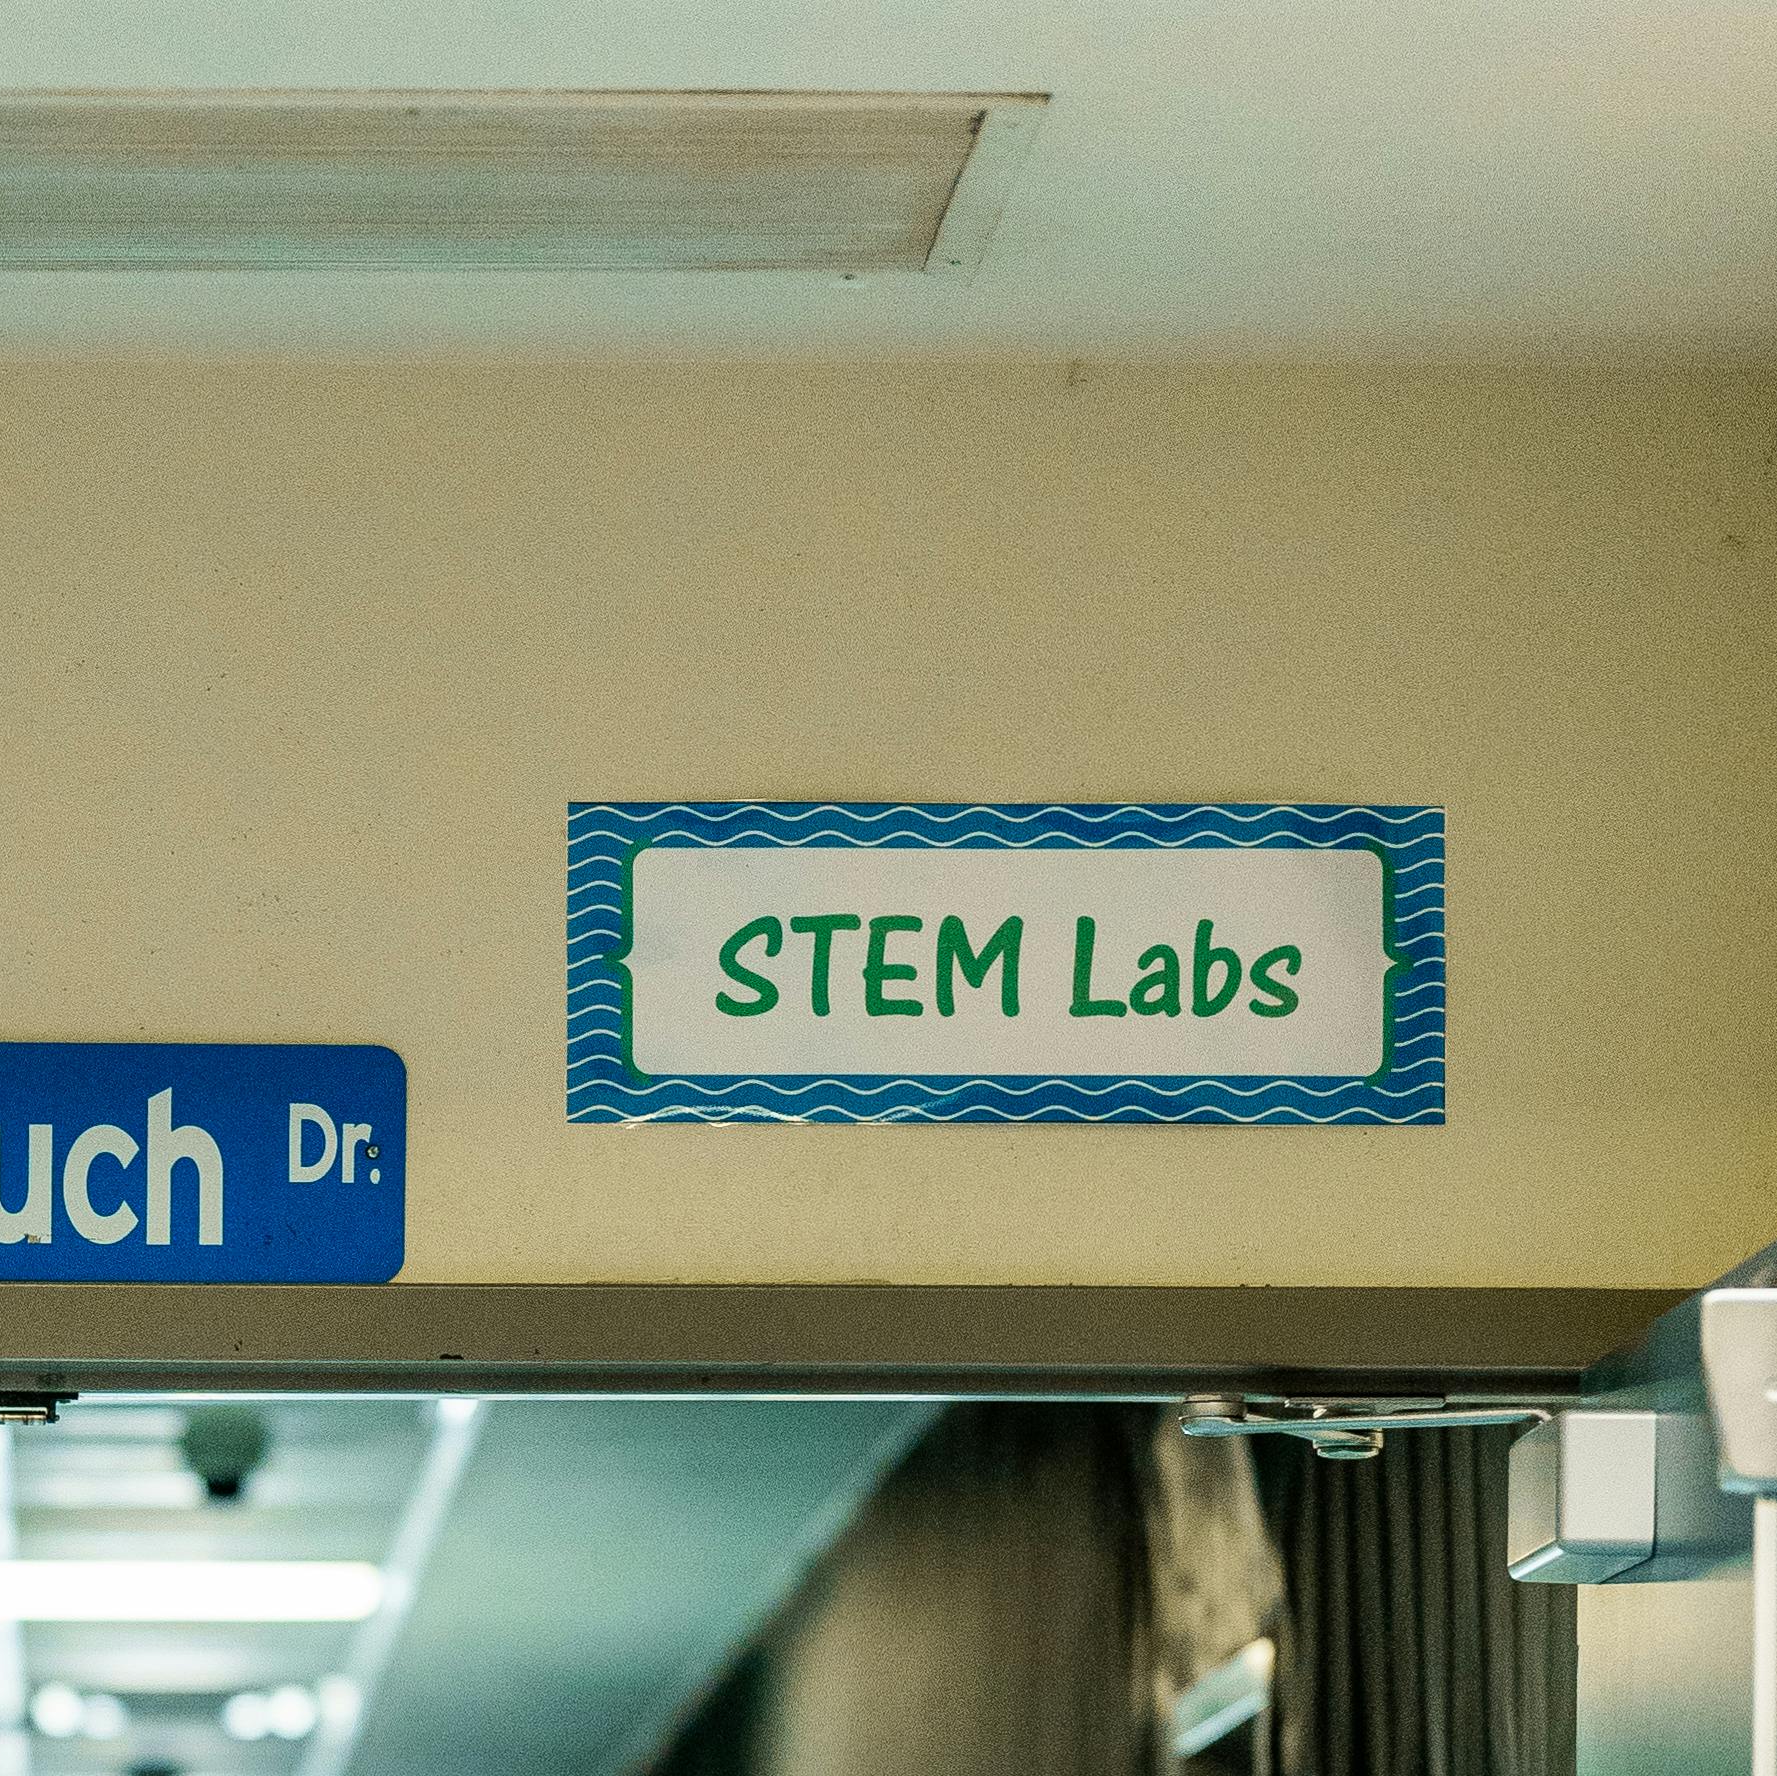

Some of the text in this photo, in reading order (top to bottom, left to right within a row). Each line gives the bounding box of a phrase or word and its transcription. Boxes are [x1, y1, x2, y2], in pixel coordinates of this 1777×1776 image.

[713, 914, 1304, 1020] STEM Labs
[288, 1102, 382, 1185] Dr.
